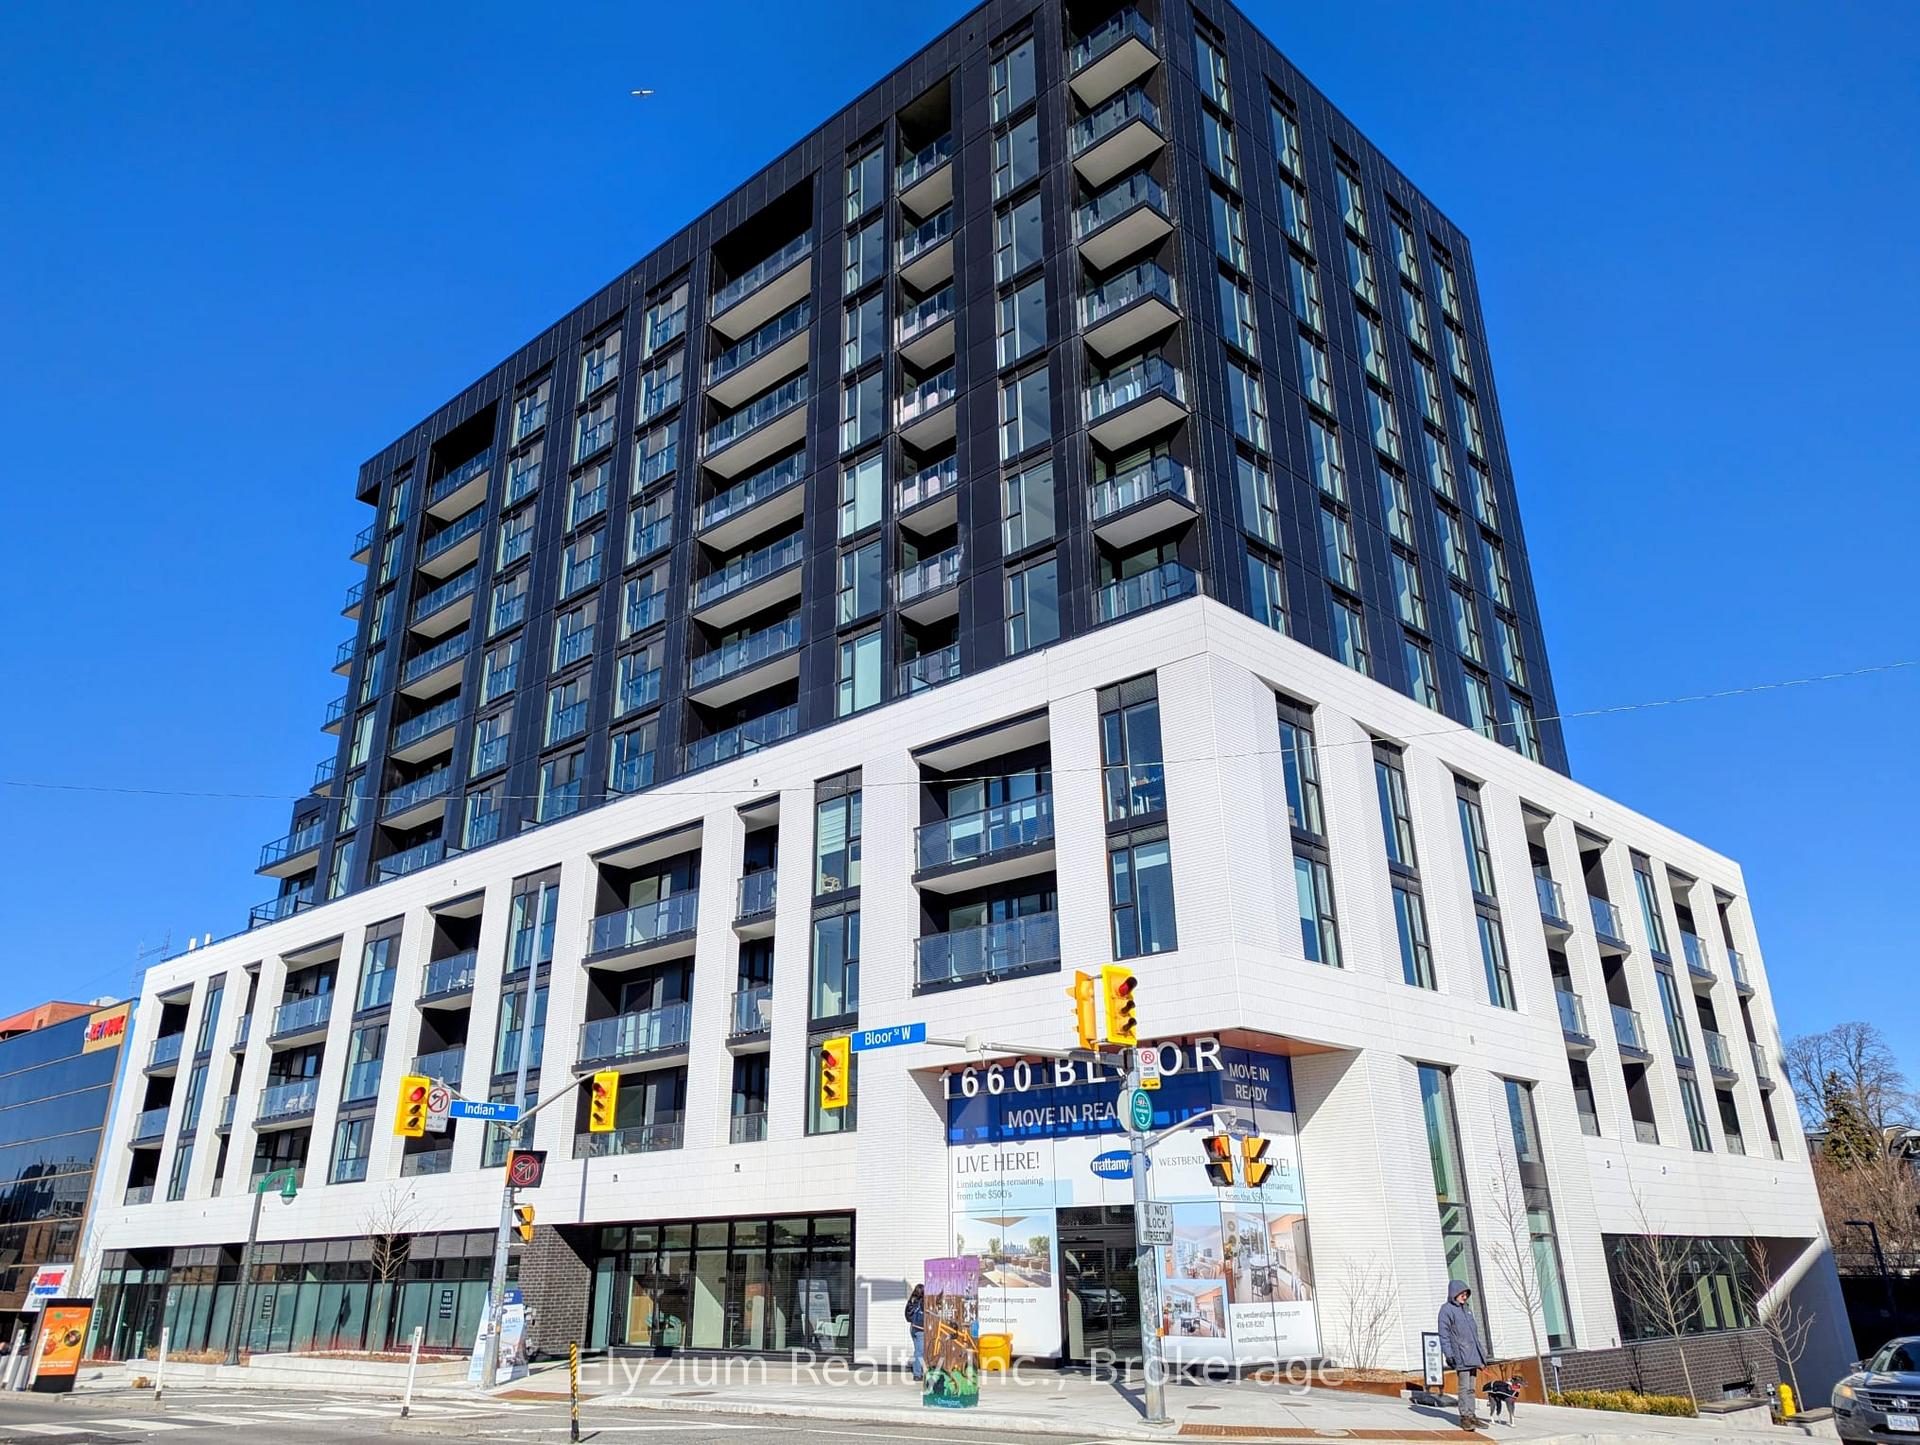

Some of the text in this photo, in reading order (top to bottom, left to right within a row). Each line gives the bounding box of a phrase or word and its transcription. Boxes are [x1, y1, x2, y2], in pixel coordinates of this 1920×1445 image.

[864, 1031, 893, 1046] Bloor
[901, 1025, 911, 1041] W
[939, 1037, 1224, 1100] 1660 BLOR
[1229, 1063, 1270, 1082] MOVE IN
[1235, 1084, 1269, 1103] READY
[464, 1102, 495, 1116] Indian
[1008, 1107, 1056, 1129] MOVE
[1059, 1104, 1078, 1124] IN
[957, 1151, 1041, 1174] LIVE HERE!
[1158, 1155, 1206, 1167] WESTBEND
[956, 1176, 1044, 1189] Limited suites remaining
[956, 1192, 974, 1201] from
[974, 1190, 987, 1200] the
[1154, 1205, 1168, 1216] NOT
